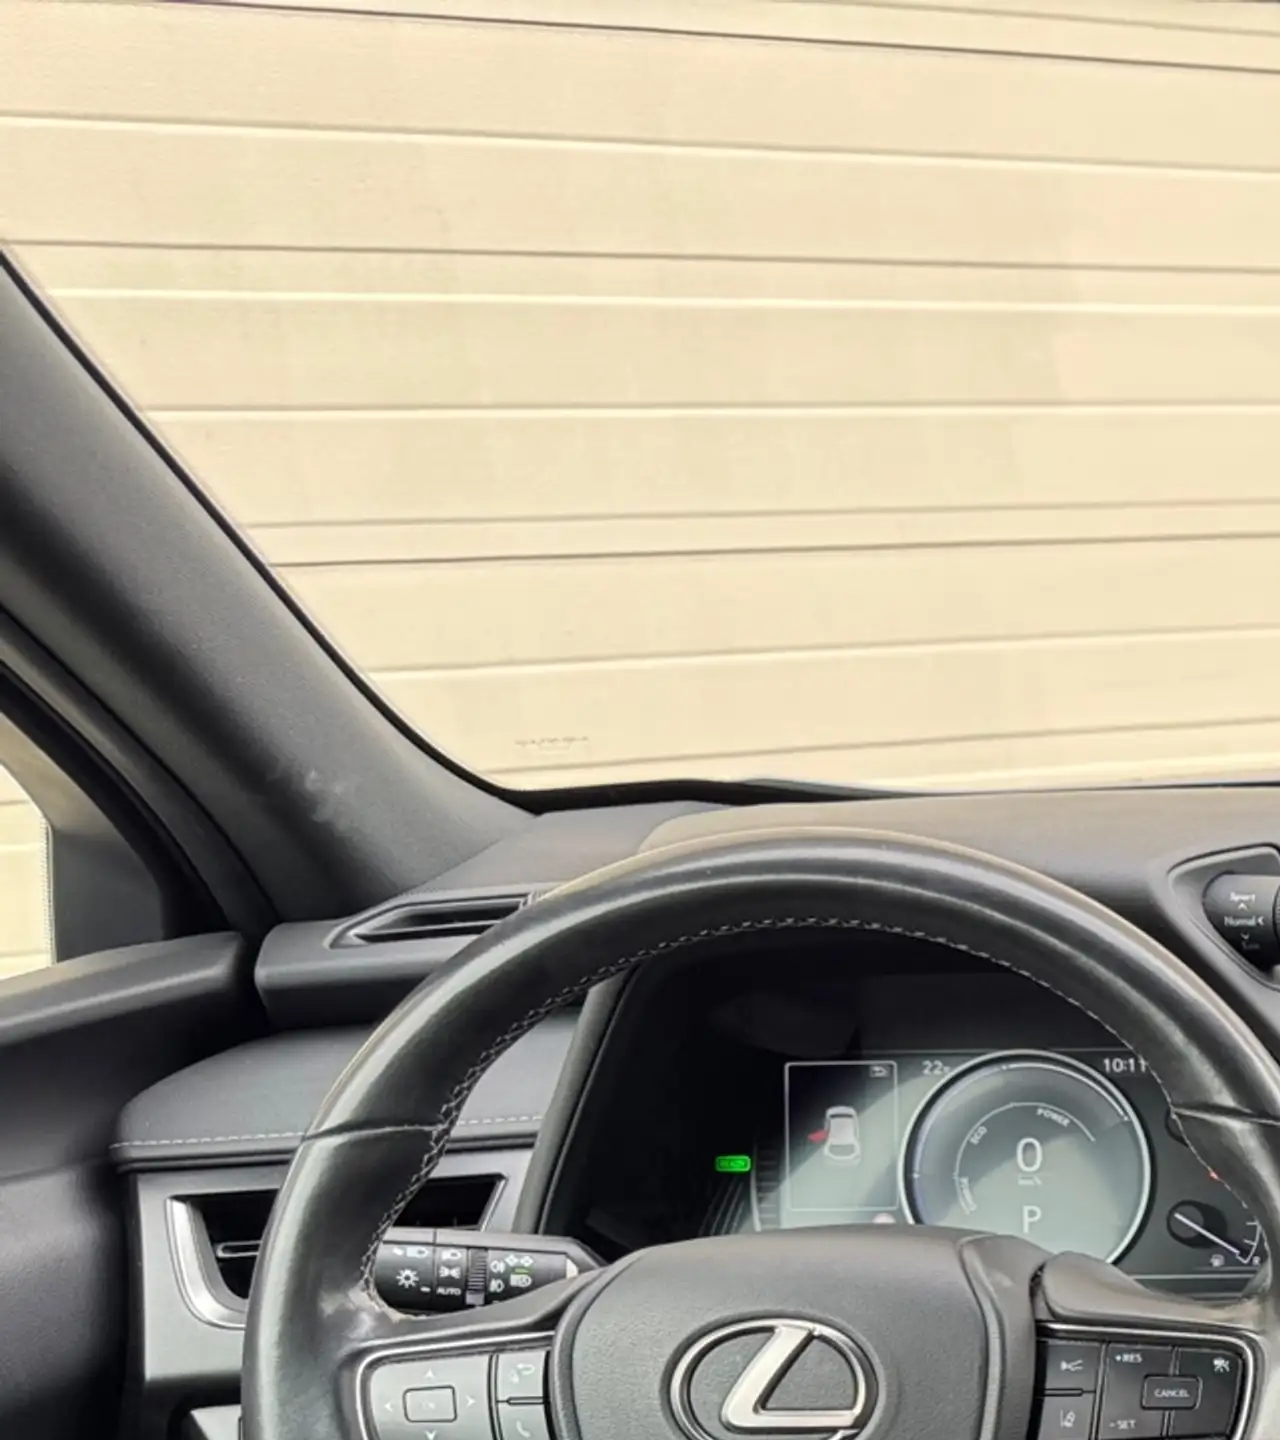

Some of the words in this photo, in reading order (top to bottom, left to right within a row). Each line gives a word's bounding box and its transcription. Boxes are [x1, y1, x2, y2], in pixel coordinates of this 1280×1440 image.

[1102, 1057, 1147, 1073] 10:11
[1035, 1107, 1071, 1129] POWER
[1016, 1137, 1043, 1173] 0
[1022, 1205, 1042, 1234] P
[435, 1286, 462, 1297] AUTO
[1153, 1388, 1190, 1399] CANCEL
